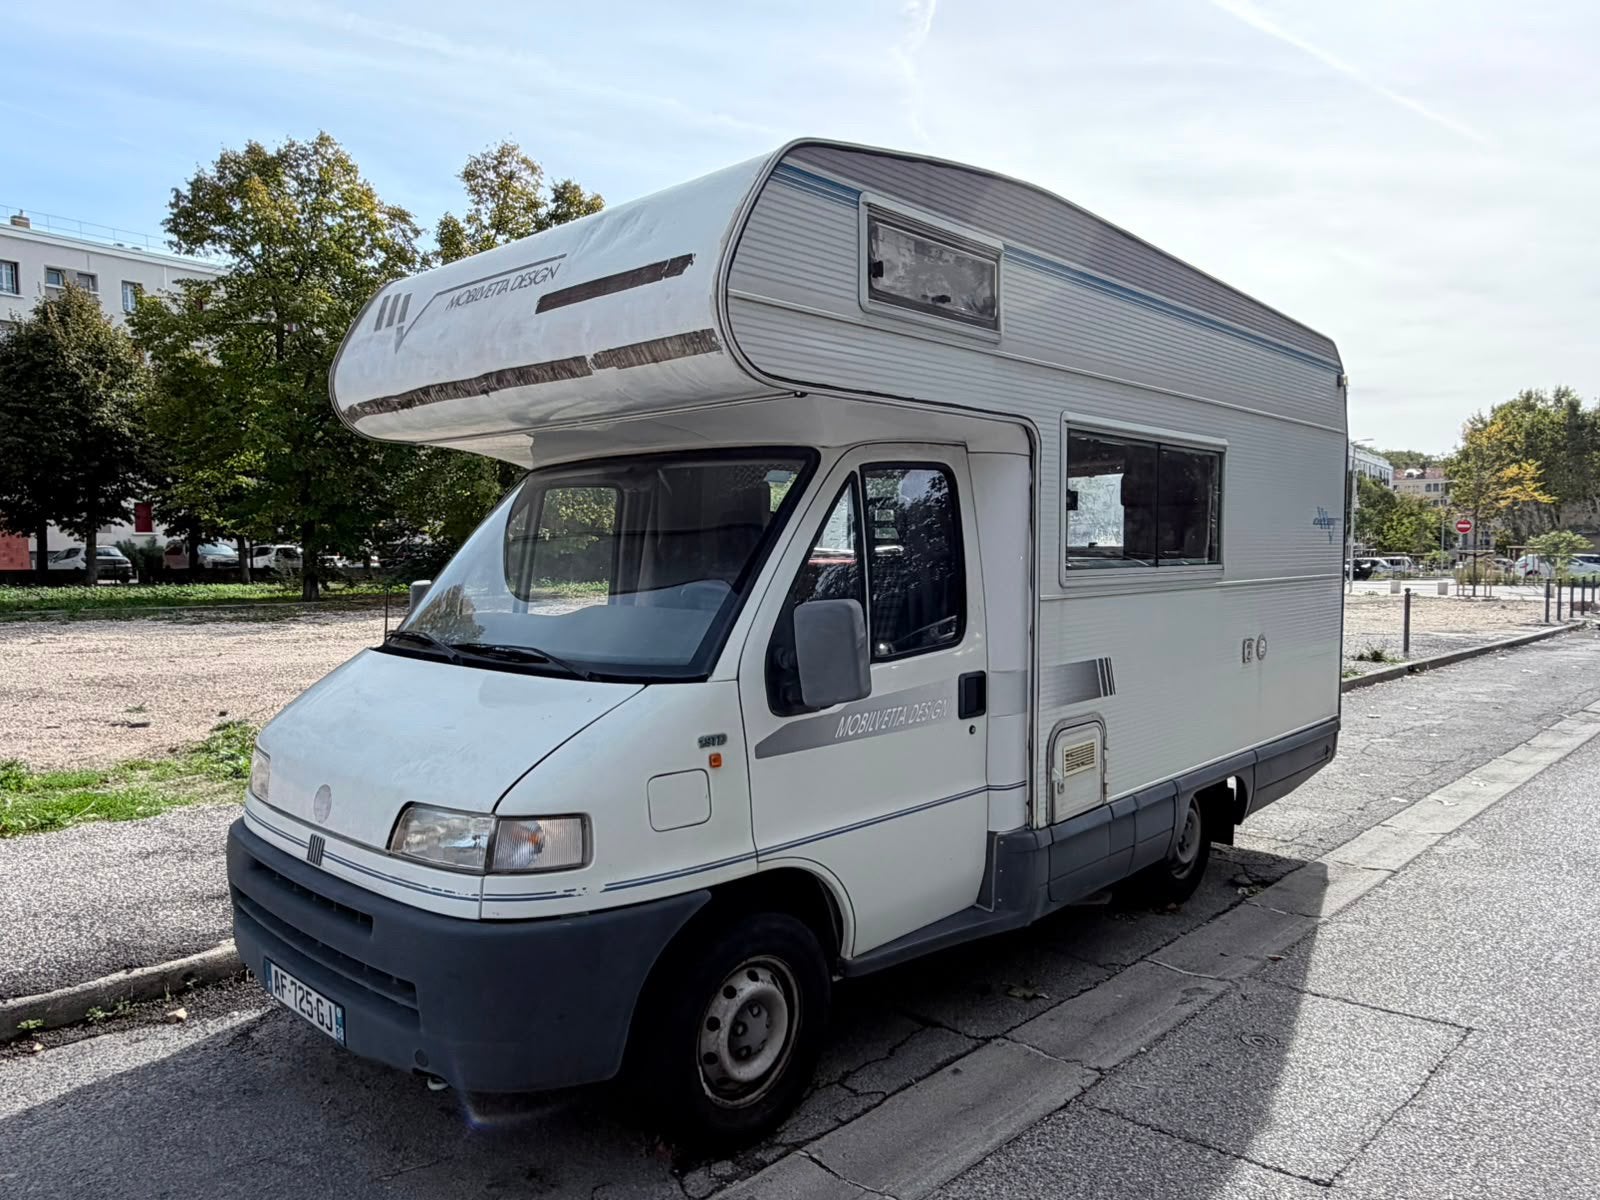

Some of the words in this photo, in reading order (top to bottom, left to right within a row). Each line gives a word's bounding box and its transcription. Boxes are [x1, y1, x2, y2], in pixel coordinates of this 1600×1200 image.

[446, 279, 510, 311] MOBILVETTA
[510, 263, 561, 292] DESIGN
[835, 706, 908, 738] MOBILVETTA
[908, 699, 951, 724] DESIGN
